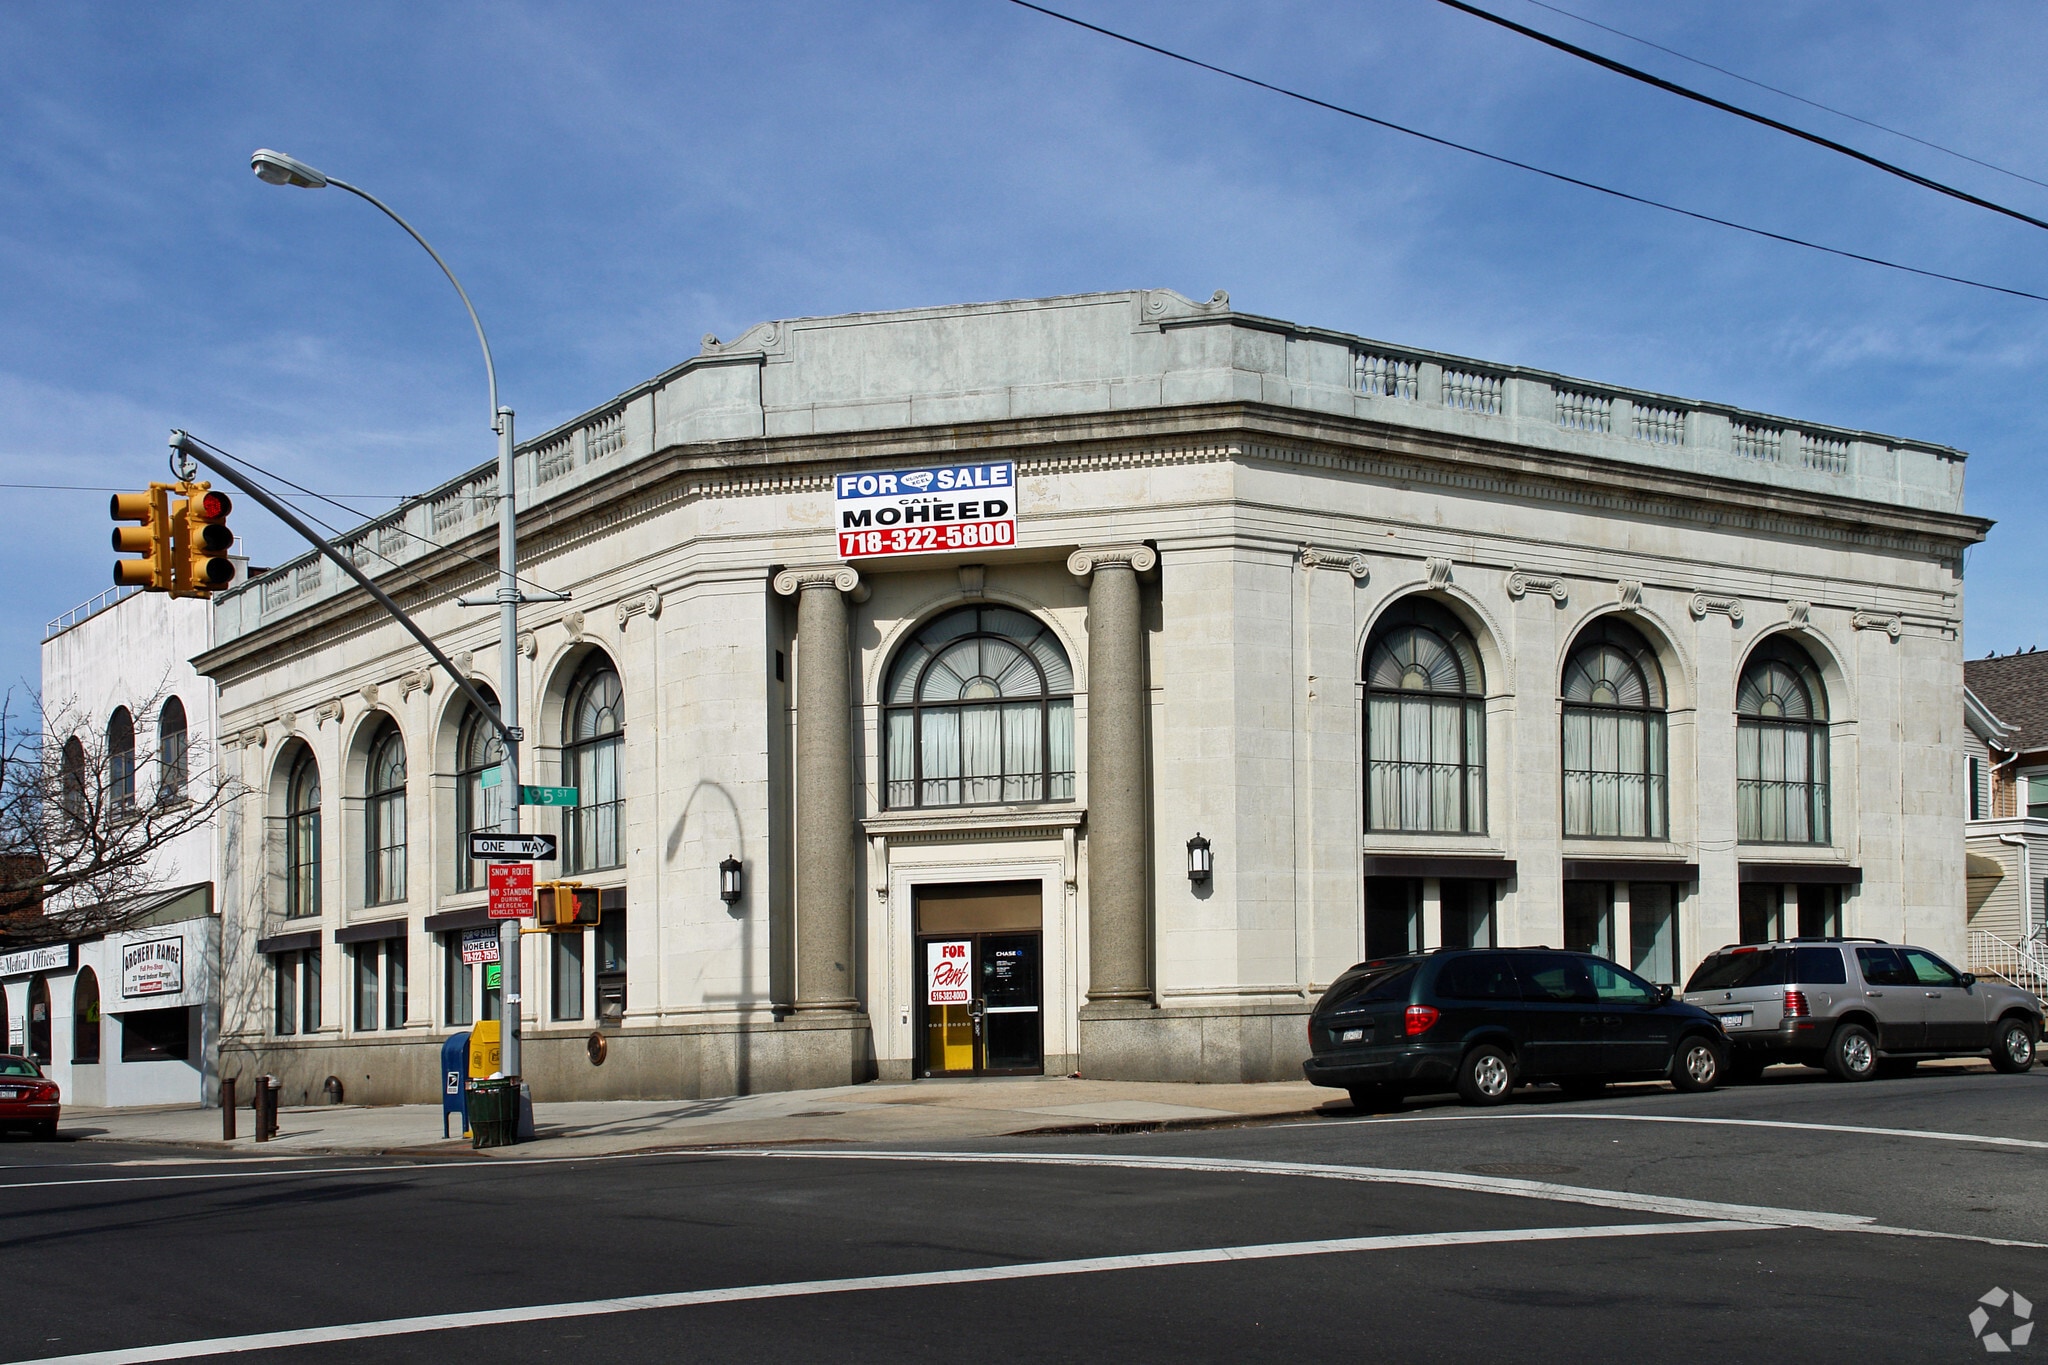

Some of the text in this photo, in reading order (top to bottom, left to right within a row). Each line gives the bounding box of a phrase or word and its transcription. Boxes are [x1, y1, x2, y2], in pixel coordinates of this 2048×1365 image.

[841, 466, 1008, 497] FOR SALE
[898, 497, 942, 505] CALL
[842, 499, 1009, 528] MOHEED
[842, 522, 1011, 555] 718-322-5800
[531, 789, 568, 804] 95 ST
[481, 841, 546, 853] ONE WAY
[491, 867, 531, 876] SNOW ROUTE
[502, 887, 532, 896] STANDING
[463, 928, 496, 940] FOR SALE
[463, 941, 496, 951] MOHEED
[942, 945, 965, 958] FOR
[6, 952, 30, 973] Medical
[32, 949, 56, 969] Offices
[125, 944, 179, 971] ARCHERY RANGE
[932, 961, 968, 987] Rent
